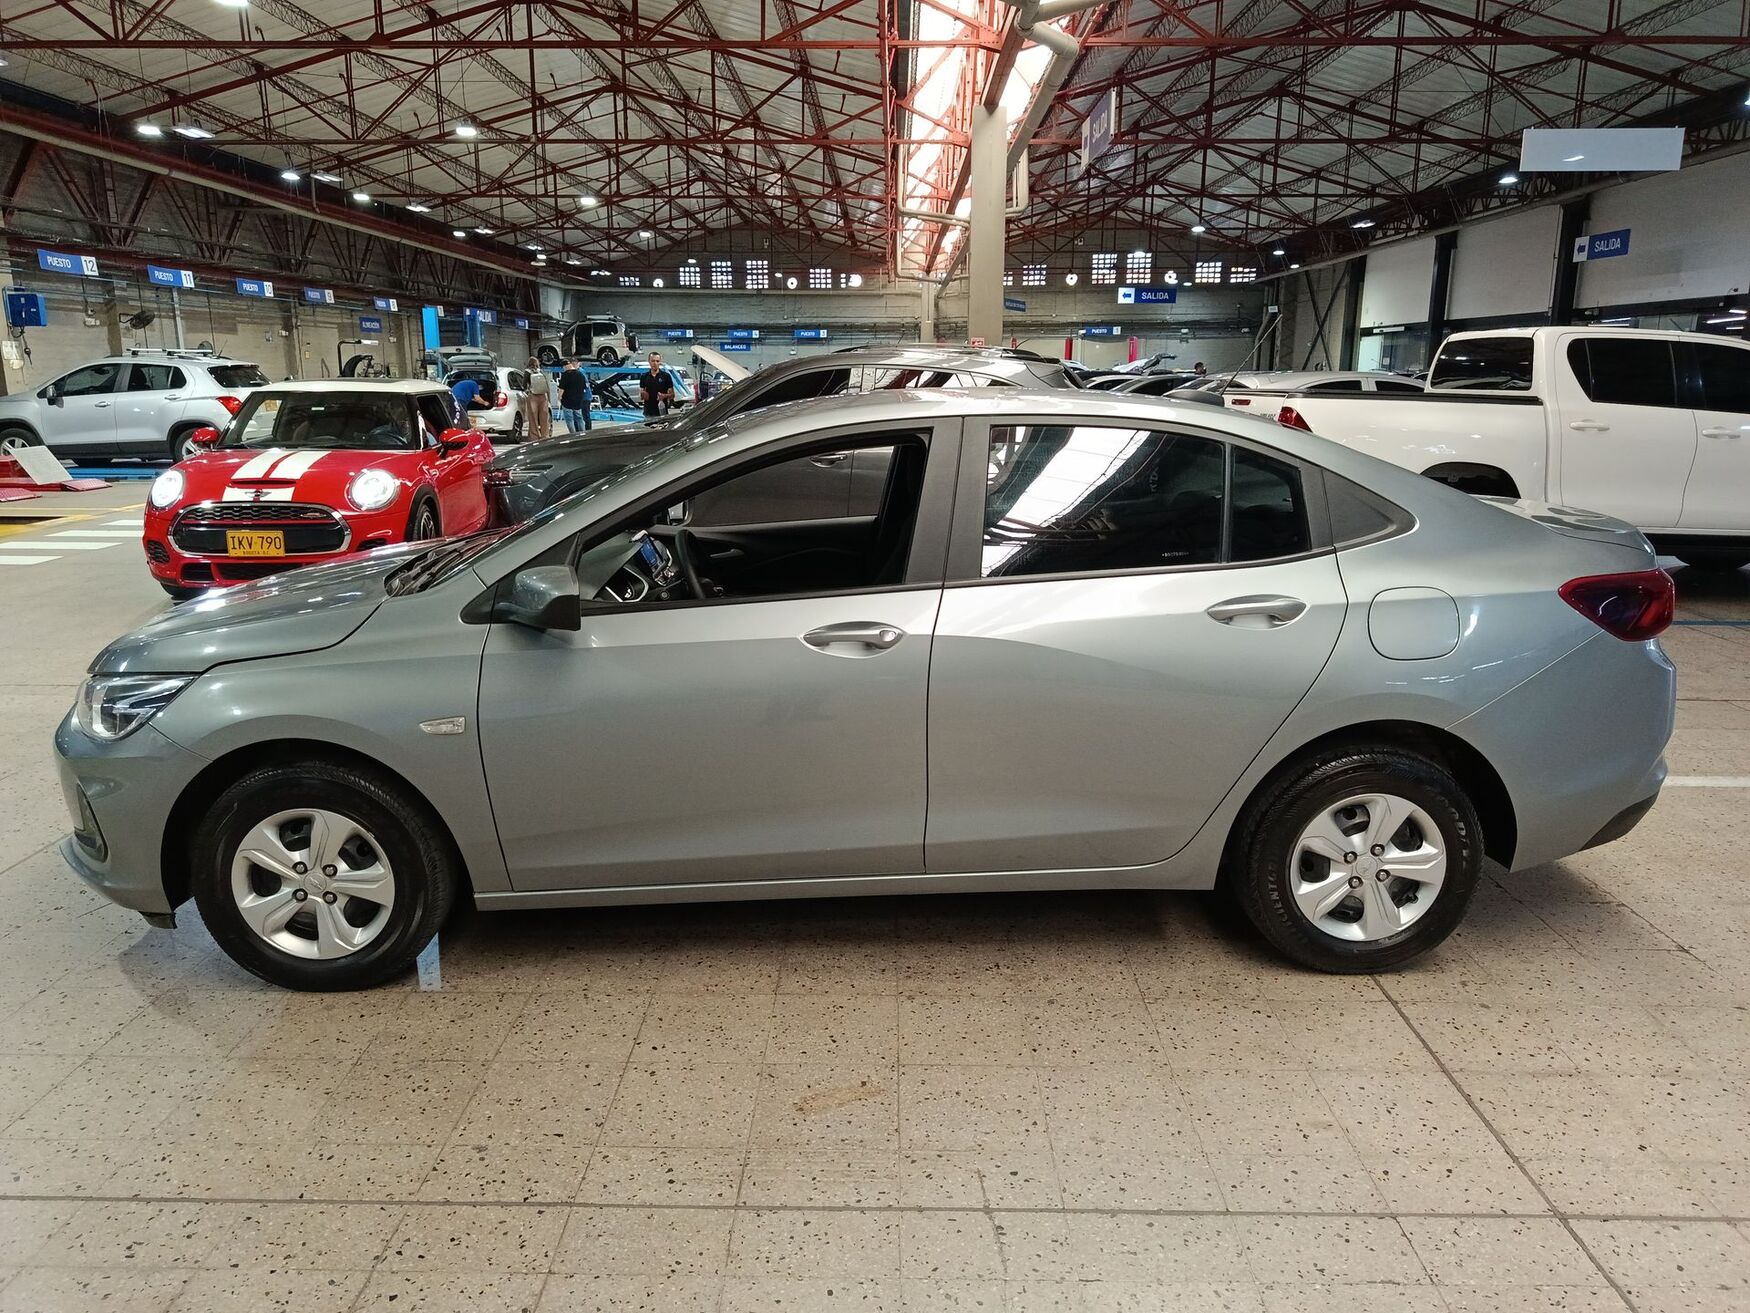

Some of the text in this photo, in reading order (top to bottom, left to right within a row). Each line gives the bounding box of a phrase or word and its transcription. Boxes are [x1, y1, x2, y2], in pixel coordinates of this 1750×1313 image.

[1594, 237, 1621, 252] SALIDA
[47, 255, 97, 273] PUESTO 12
[154, 270, 193, 286] PUESTO 11
[1141, 292, 1169, 300] SALIDA
[230, 536, 282, 550] IKV 790
